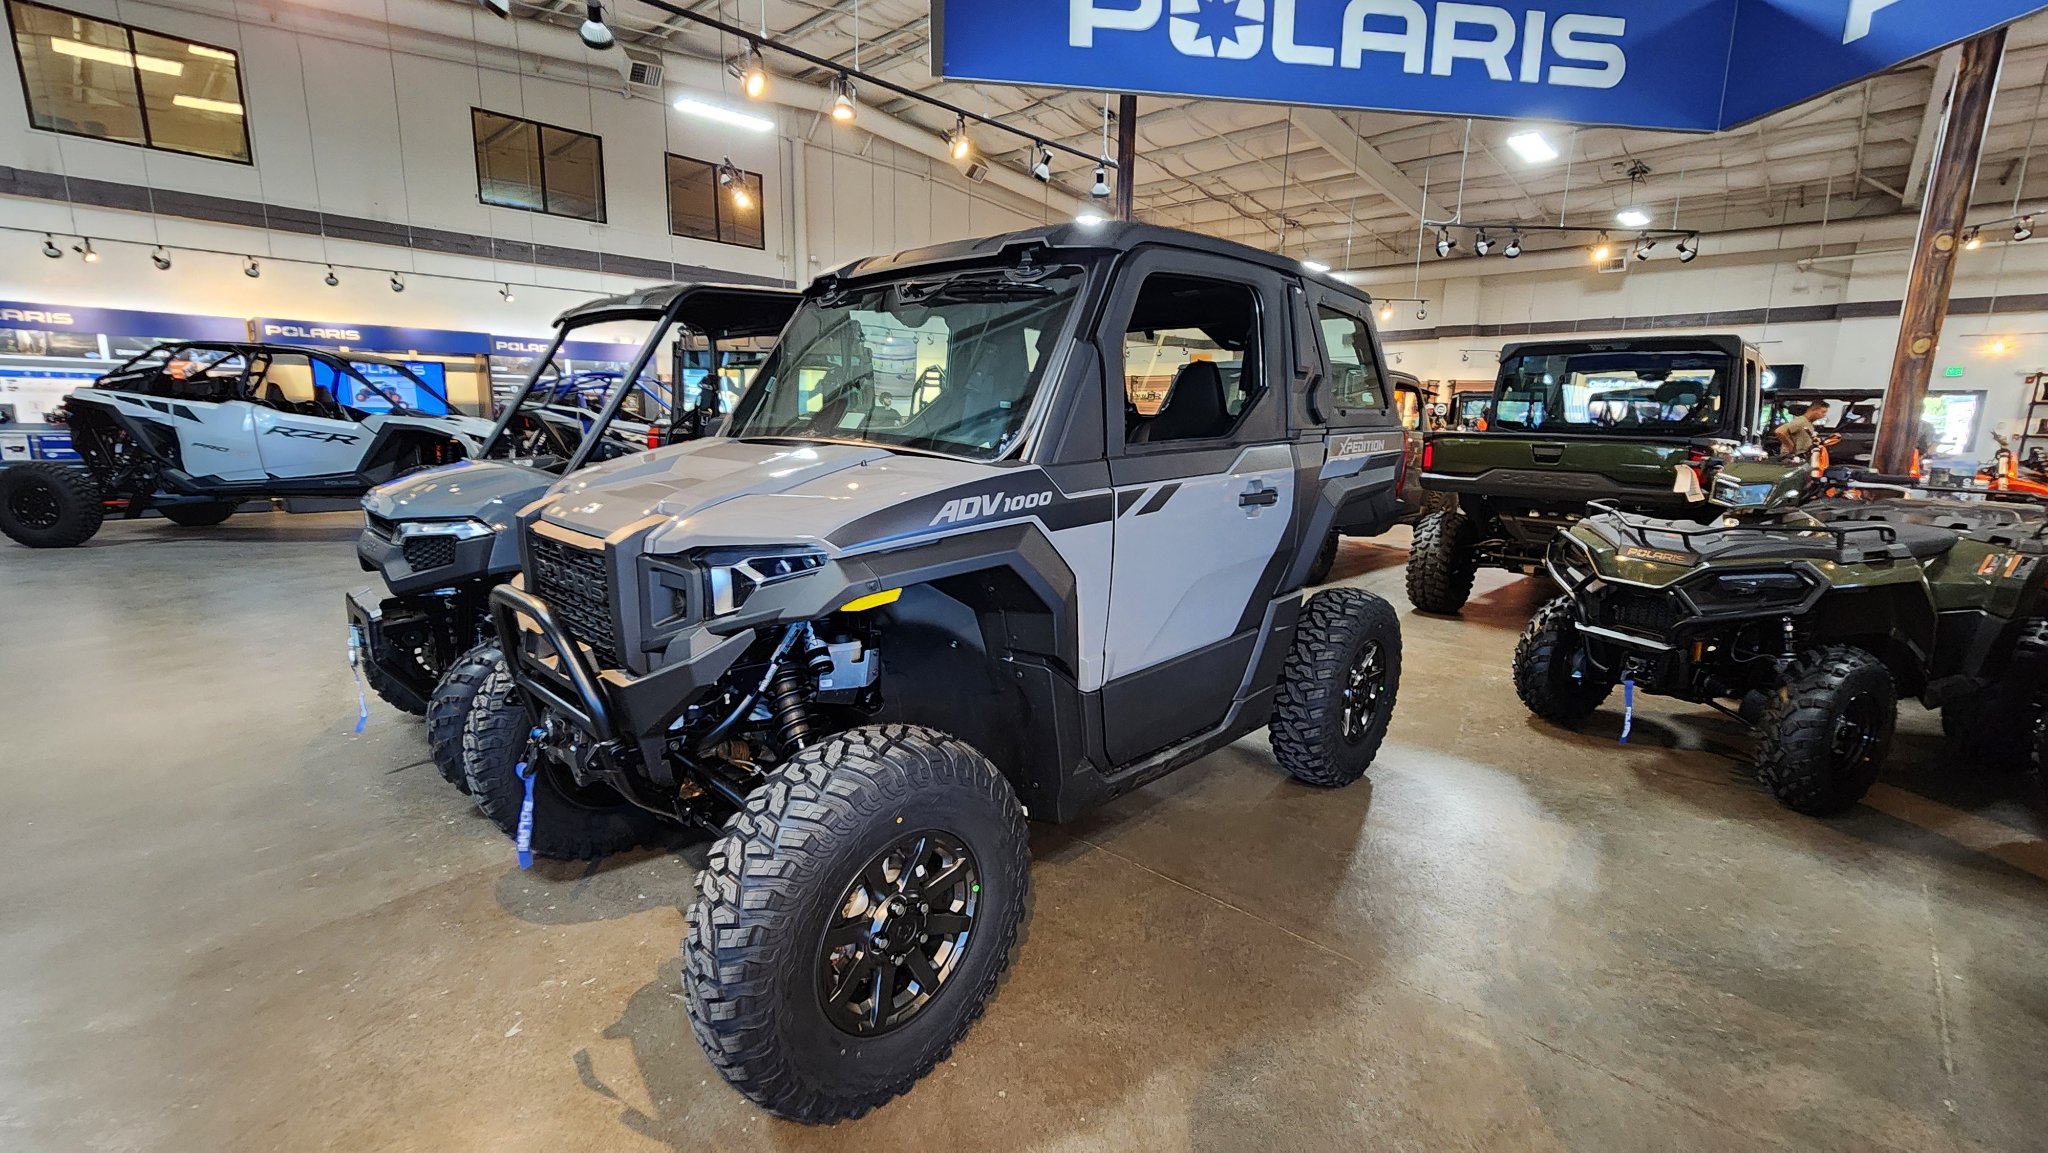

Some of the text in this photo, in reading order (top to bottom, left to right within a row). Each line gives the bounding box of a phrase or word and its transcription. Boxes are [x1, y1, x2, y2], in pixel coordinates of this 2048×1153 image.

[1069, 0, 1627, 89] POLARIS
[0, 308, 74, 325] ARIS
[264, 324, 361, 341] POLARIS
[495, 341, 565, 354] POLARS
[350, 361, 426, 376] OLAS
[264, 425, 361, 446] RZR
[1339, 436, 1385, 456] XPEDITION
[928, 490, 1053, 526] ADV 1000
[1627, 547, 1686, 562] POLARIS
